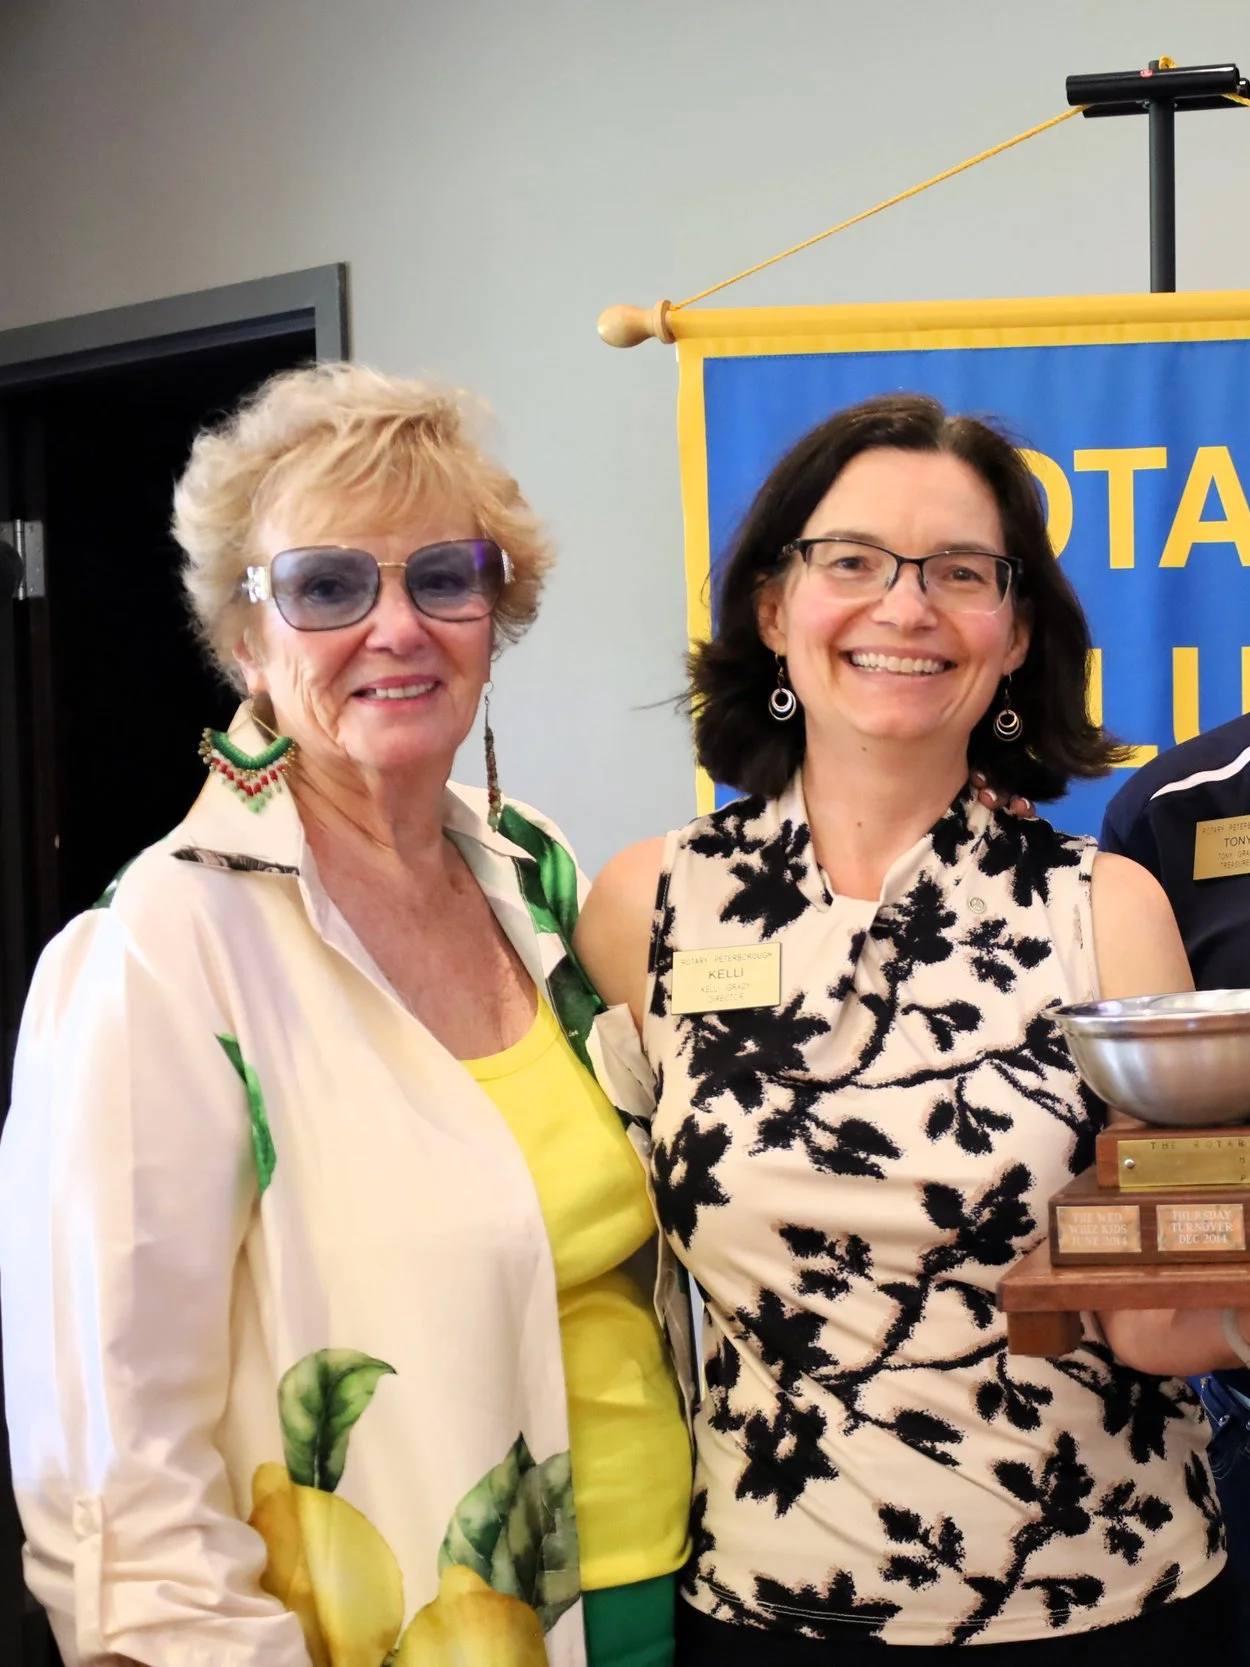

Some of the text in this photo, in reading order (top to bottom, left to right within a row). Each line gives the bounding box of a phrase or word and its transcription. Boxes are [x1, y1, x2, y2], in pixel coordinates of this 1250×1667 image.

[714, 951, 773, 963] PETERBOROUGH
[708, 967, 744, 979] KELLI
[1096, 1212, 1123, 1223] WED
[1172, 1210, 1232, 1221] THURSDAY
[1101, 1224, 1128, 1234] KIDS
[1171, 1222, 1233, 1233] TURNOVER
[1072, 1235, 1128, 1247] JUNE 2014
[1179, 1232, 1228, 1244] DEC 2014
